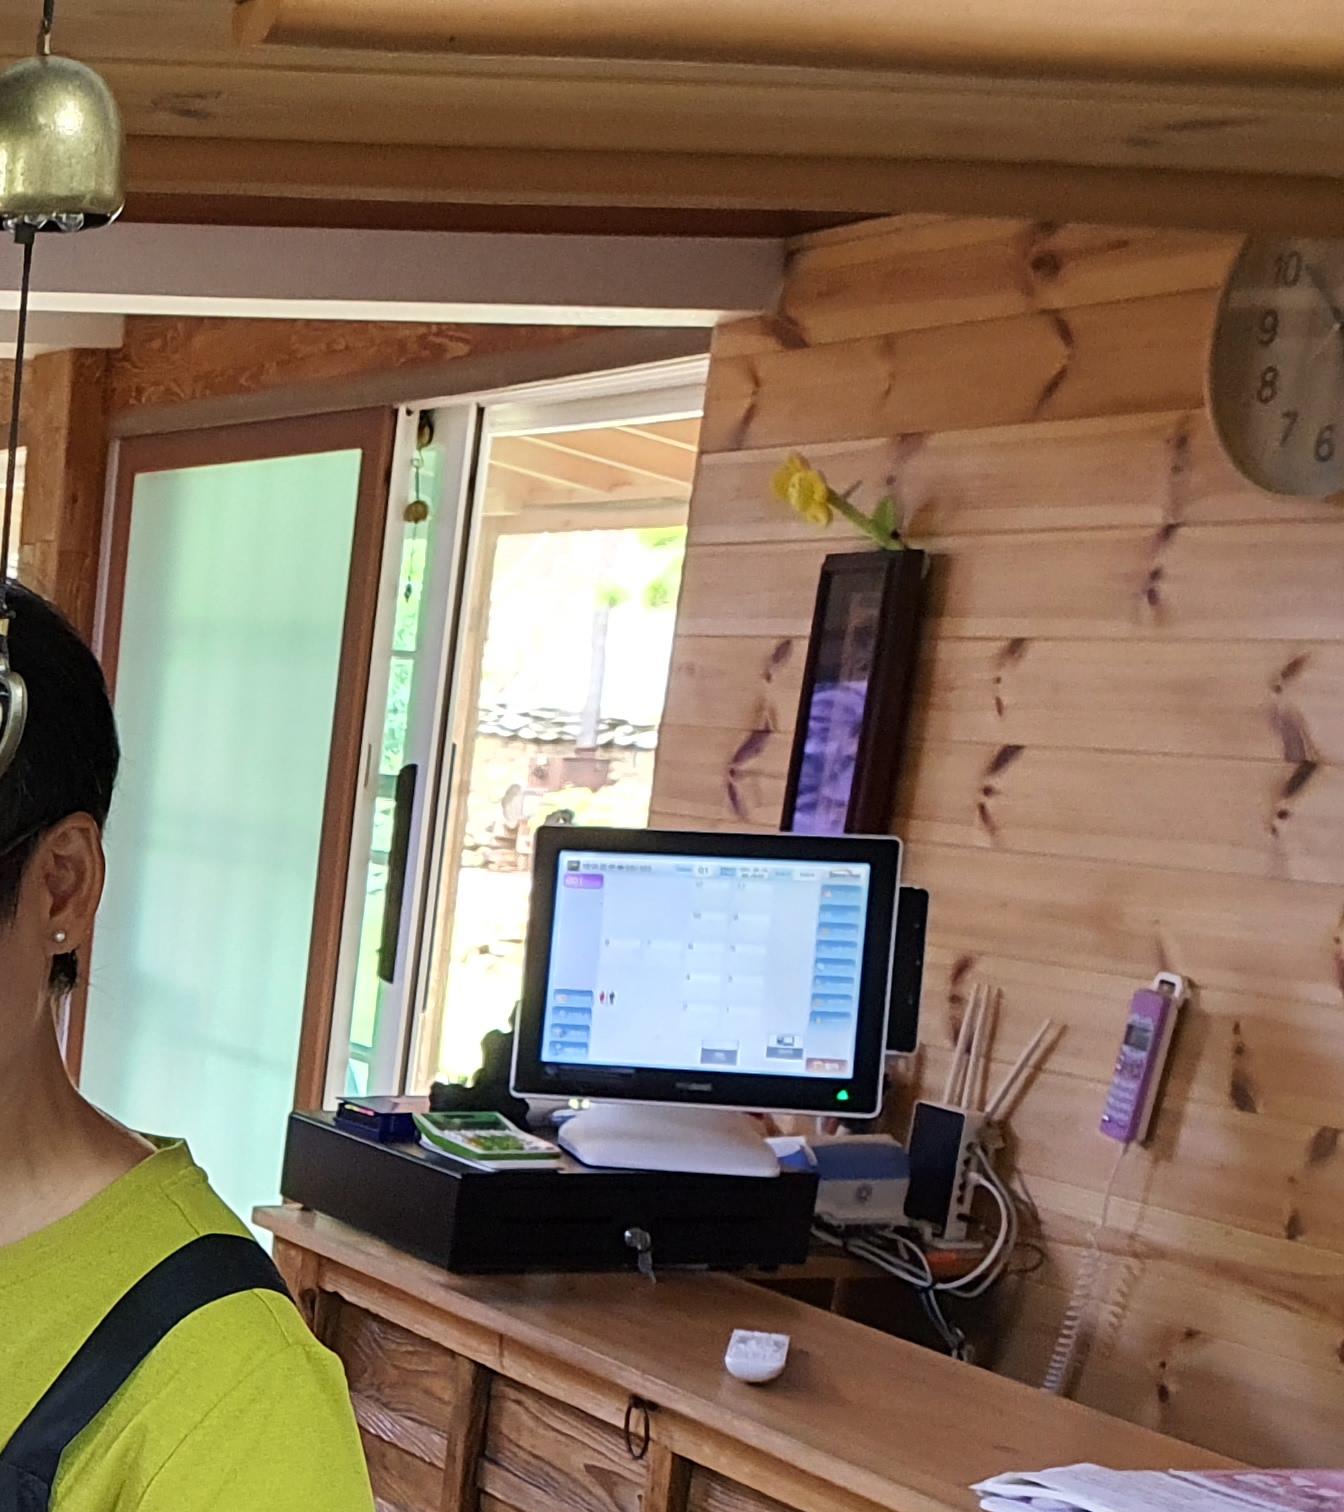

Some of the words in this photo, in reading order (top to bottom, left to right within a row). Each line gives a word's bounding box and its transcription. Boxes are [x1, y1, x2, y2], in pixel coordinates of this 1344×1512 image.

[1275, 251, 1302, 287] 10
[1257, 309, 1279, 347] 9
[1256, 366, 1278, 404] 8
[1279, 410, 1299, 447] 7
[1314, 424, 1335, 462] 6
